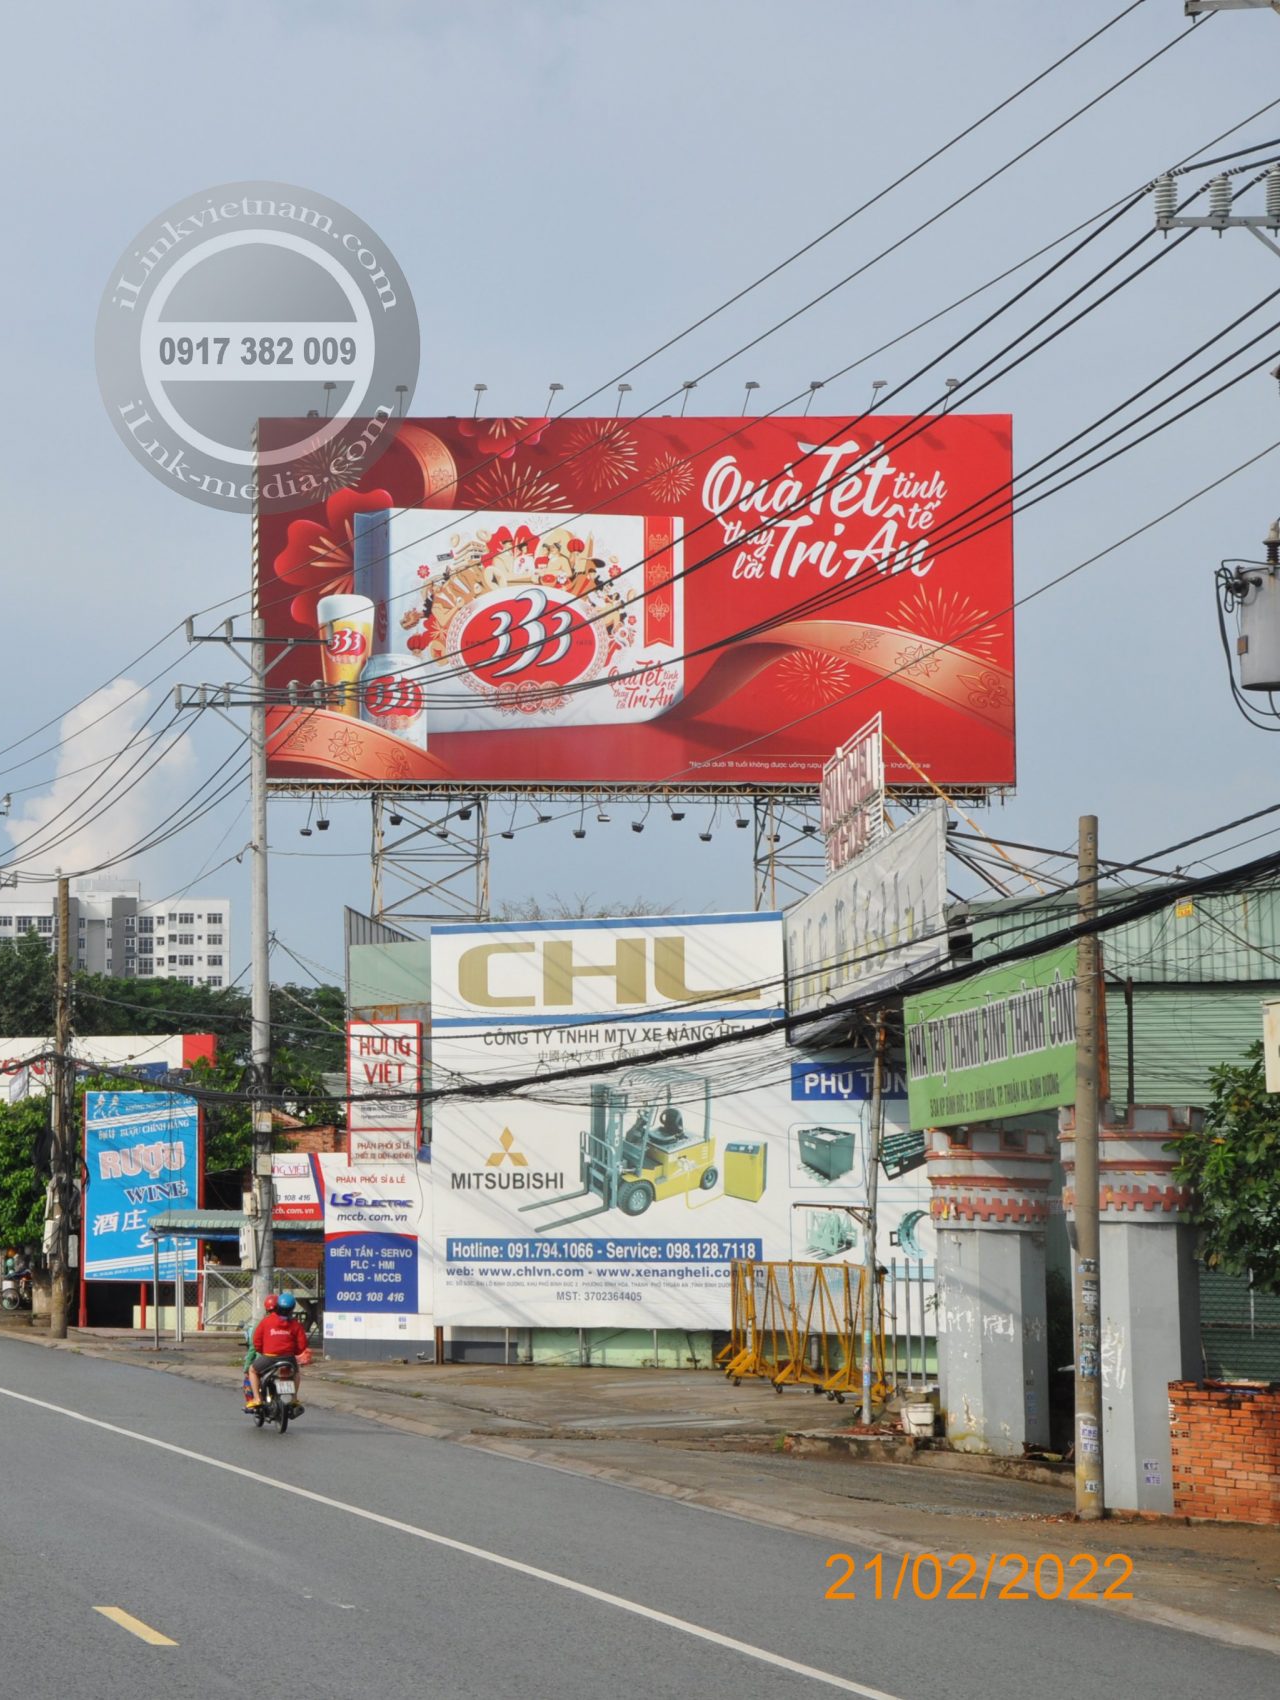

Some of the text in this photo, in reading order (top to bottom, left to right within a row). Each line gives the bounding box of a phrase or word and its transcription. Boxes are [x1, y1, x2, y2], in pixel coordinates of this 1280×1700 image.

[702, 455, 805, 525] Quà
[797, 440, 896, 518] Tết
[760, 514, 846, 580] Tri
[331, 628, 361, 654] 333
[475, 588, 573, 678] 333
[458, 935, 762, 1009] CHL
[483, 1027, 529, 1046] CÔNG
[559, 1029, 600, 1045] TNHH
[604, 1028, 636, 1043] MTV
[642, 1027, 662, 1041] XE
[666, 1022, 715, 1041] NÂNG
[908, 968, 1077, 1087] NHÀ TRỌ THANH BÌNH THÀNH CÔN
[364, 1060, 405, 1087] VIỆT
[804, 1072, 854, 1099] PHỤ
[98, 1140, 186, 1181] RƯỢU
[124, 1180, 188, 1206] WINE
[450, 1171, 565, 1191] MITSUBISHI
[330, 1193, 414, 1208] LS ELECTRIC
[92, 1209, 148, 1237] 酒庄
[381, 1247, 413, 1258] SERVO
[452, 1241, 756, 1259] Hotline: 091.794.1066 Service: 098.128.7118
[343, 1273, 402, 1282] MCB MCCB
[350, 1261, 395, 1270] PLC HMI
[446, 1266, 474, 1277] web:
[479, 1266, 584, 1277] www.chlvn.com
[336, 1291, 405, 1302] 0903 108 416
[556, 1291, 642, 1301] MST: 3702364405
